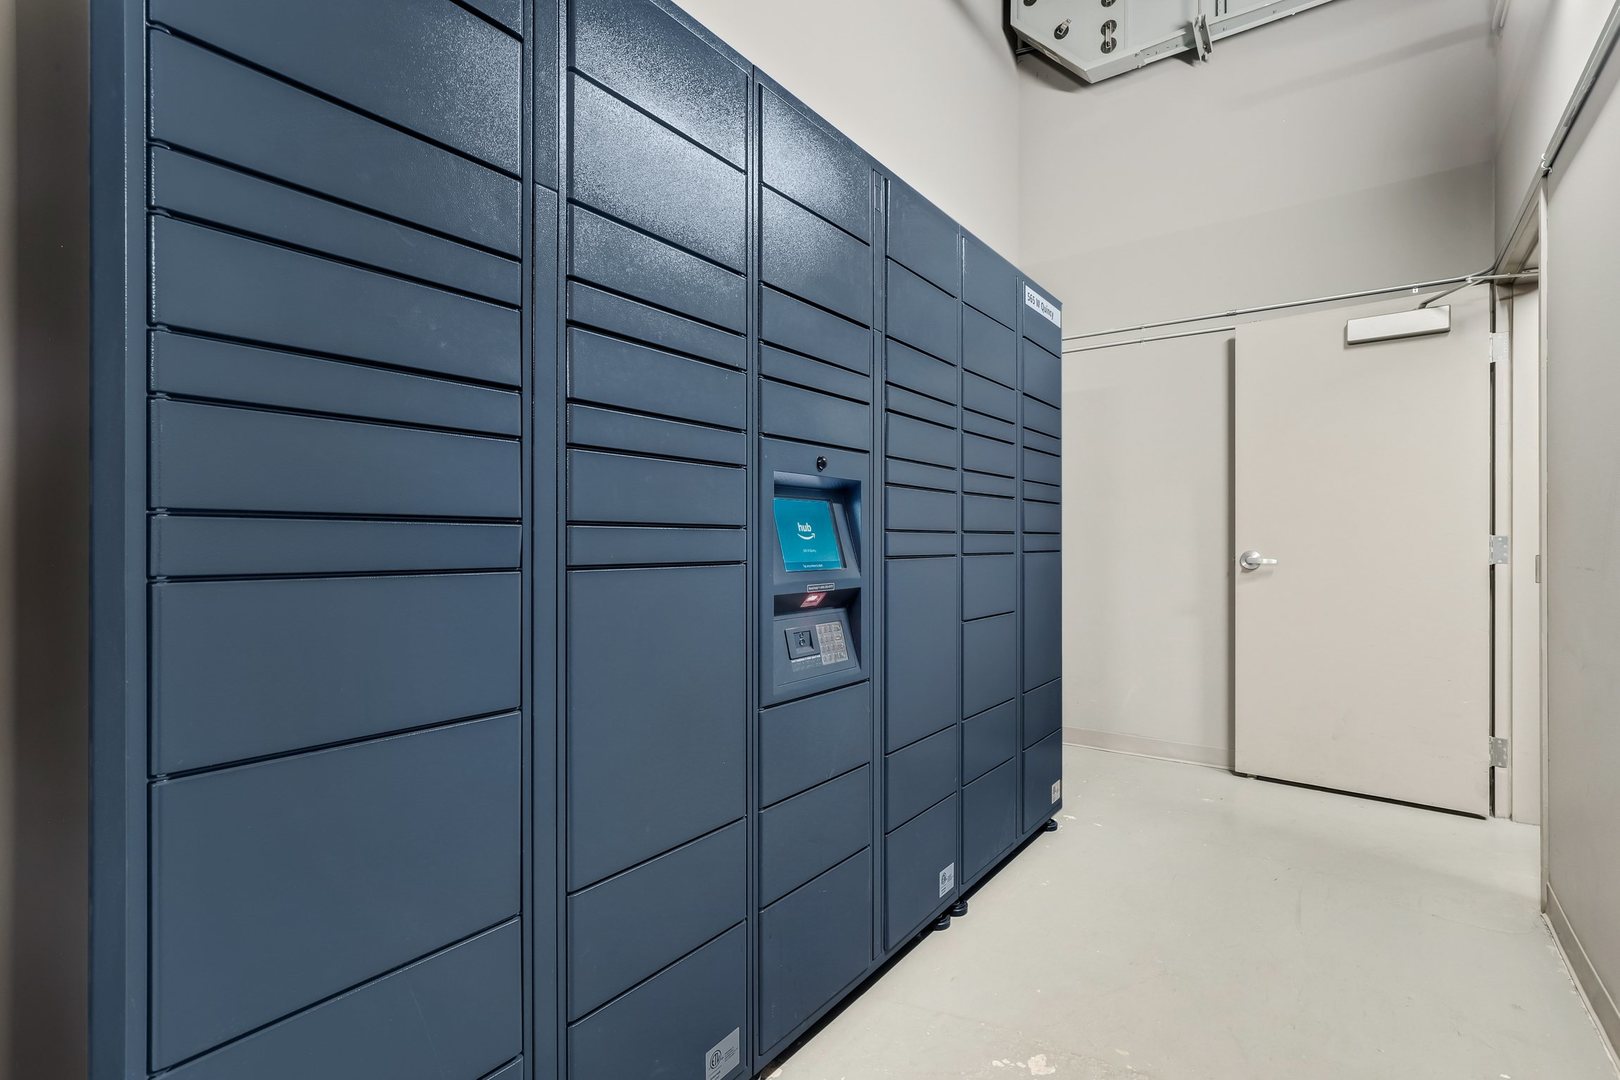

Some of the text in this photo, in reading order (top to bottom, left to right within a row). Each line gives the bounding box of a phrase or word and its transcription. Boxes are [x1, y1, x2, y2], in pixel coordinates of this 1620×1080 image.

[1027, 292, 1036, 305] 565
[1041, 302, 1054, 320] Quincy
[797, 522, 812, 532] hub
